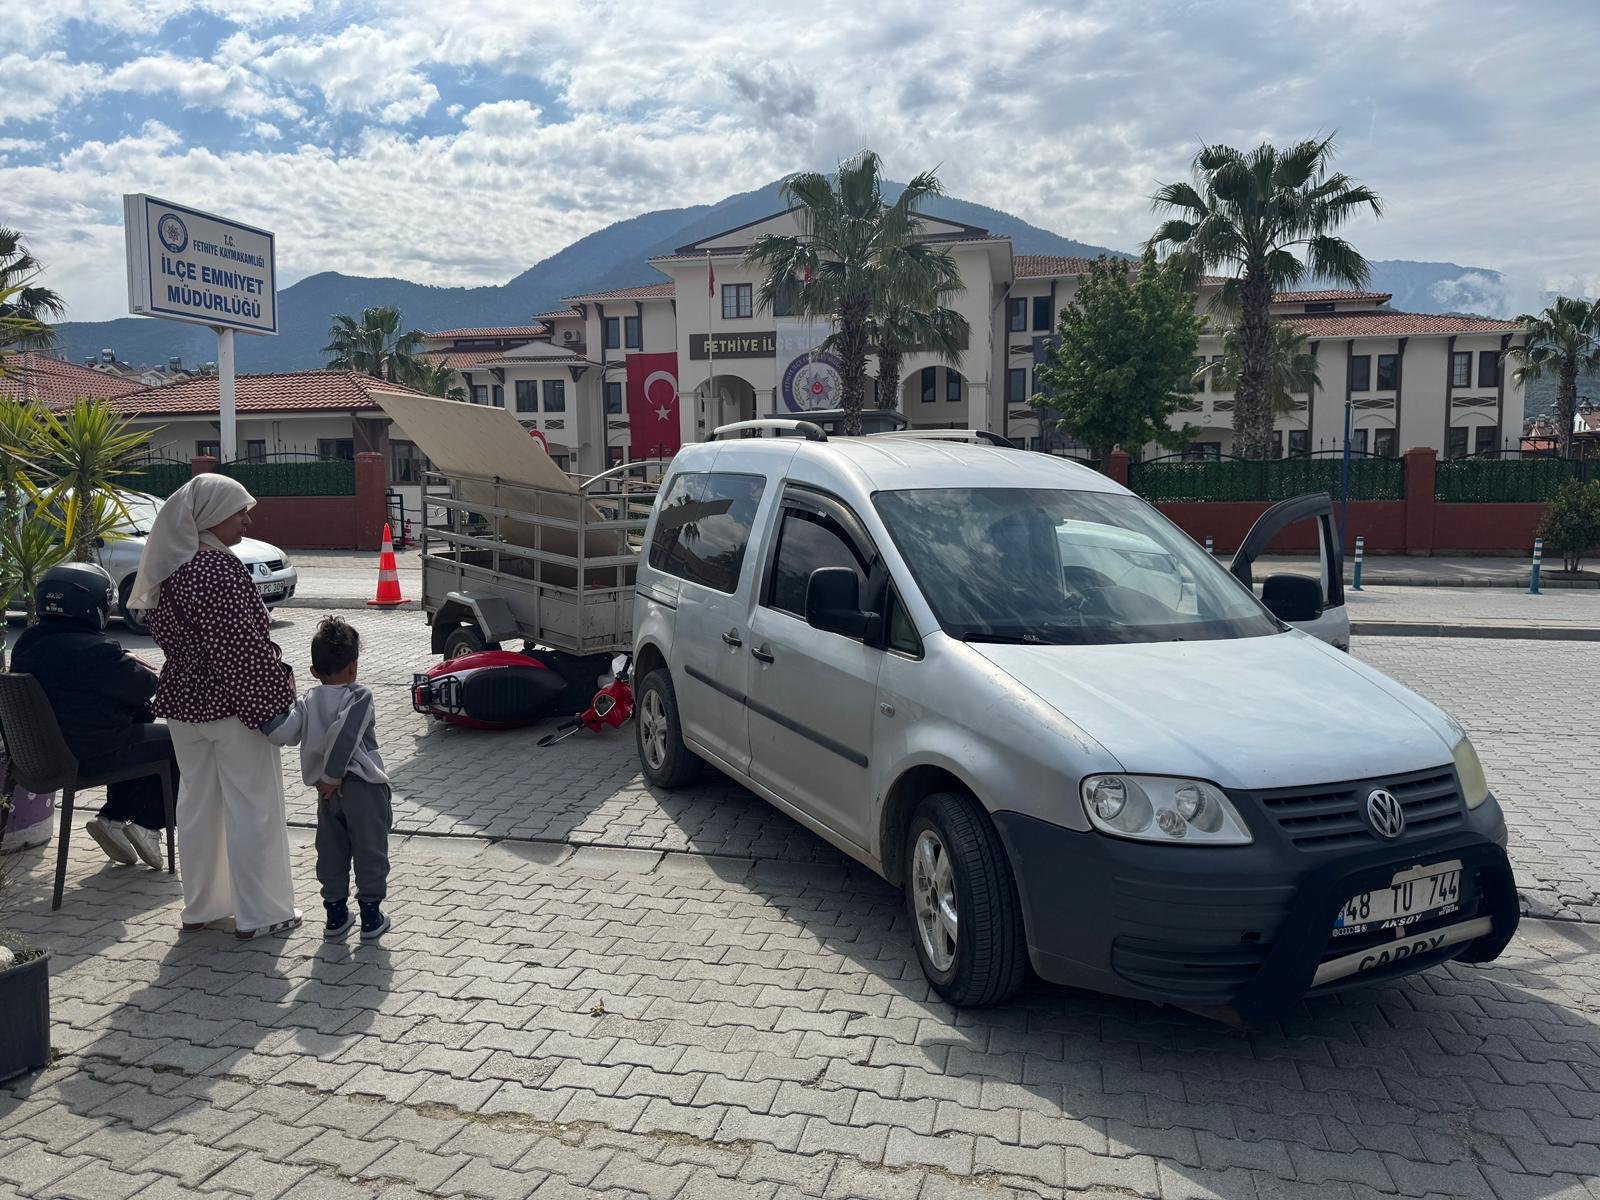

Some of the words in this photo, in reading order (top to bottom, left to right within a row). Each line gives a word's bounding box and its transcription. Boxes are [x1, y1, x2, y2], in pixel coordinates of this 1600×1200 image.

[193, 239, 219, 256] FETHİYE
[219, 247, 265, 269] KAYMAKAMLIĞI
[161, 252, 197, 282] İLÇE
[202, 265, 264, 296] EMNİYET
[167, 283, 261, 319] MÜDÜRLÜĞÜ
[703, 336, 759, 353] FETHİYE
[1346, 892, 1371, 921] 48
[1391, 882, 1414, 914] TU
[1428, 870, 1457, 906] 744
[1380, 913, 1423, 929] AKSOY
[1357, 934, 1446, 972] CADDY
